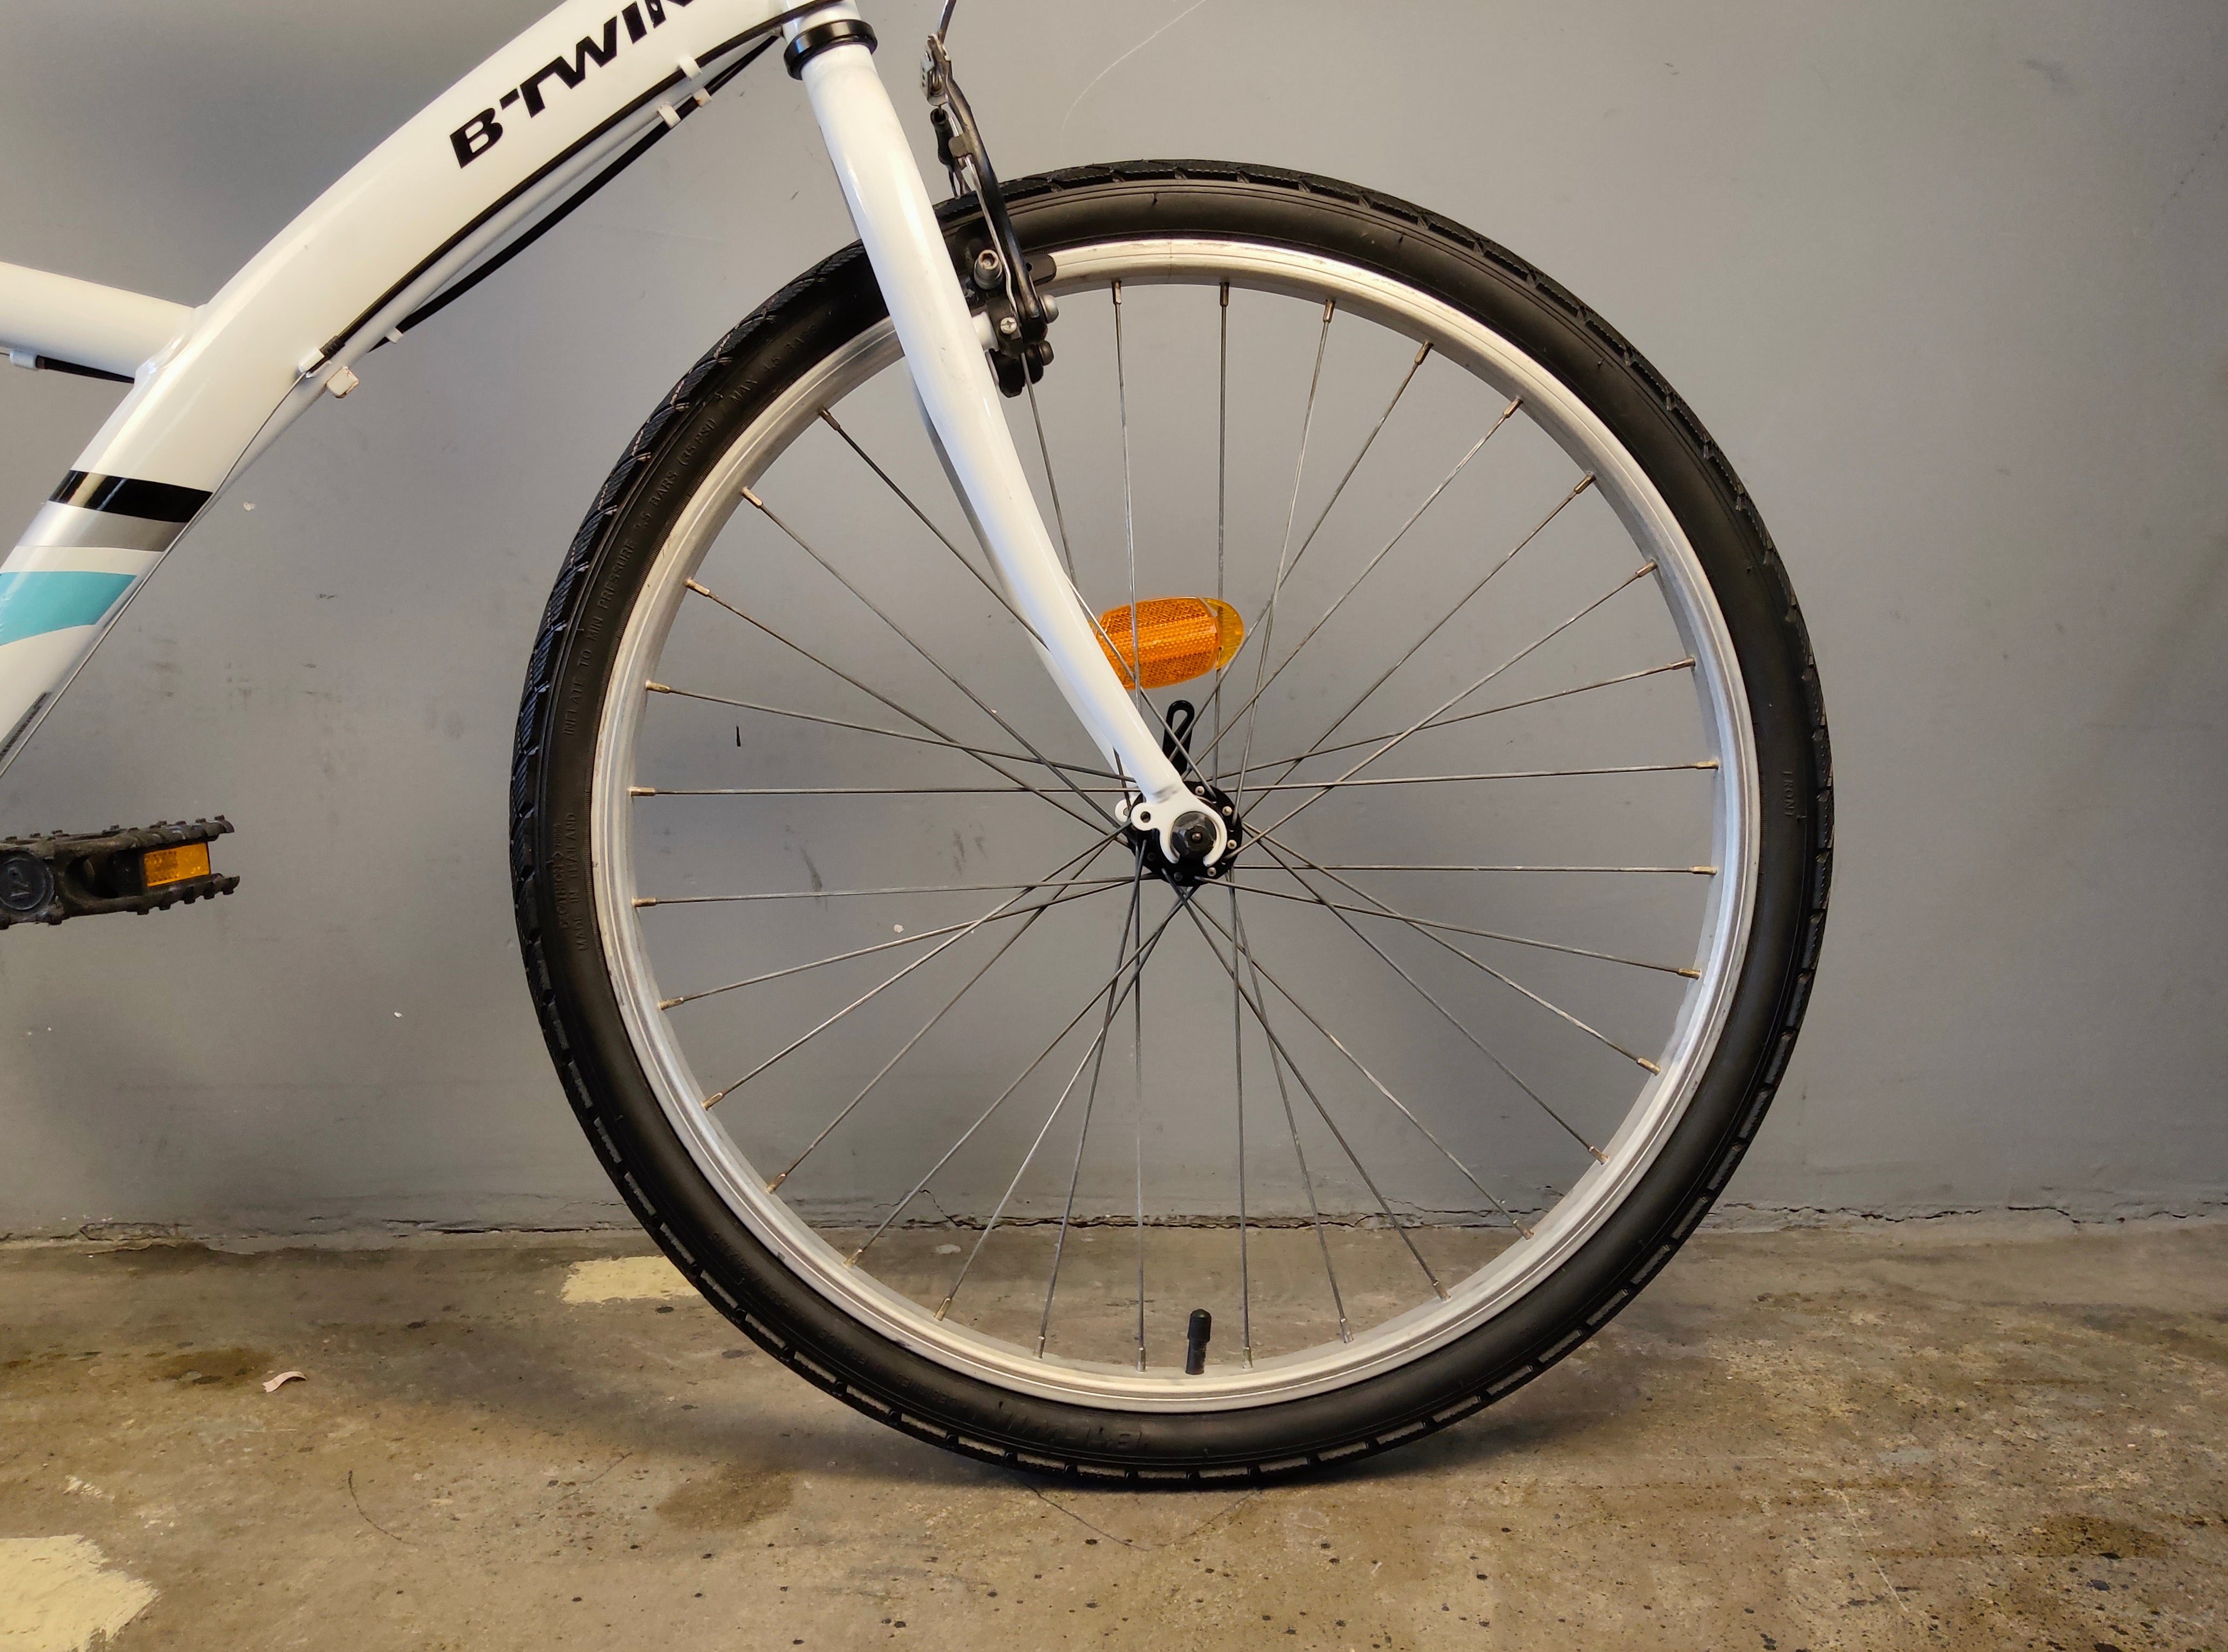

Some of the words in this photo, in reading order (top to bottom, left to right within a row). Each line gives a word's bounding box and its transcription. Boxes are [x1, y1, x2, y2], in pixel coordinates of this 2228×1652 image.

[578, 648, 592, 667] TO
[586, 616, 603, 641] MIN
[597, 539, 636, 609] PRESSURE
[649, 469, 678, 507] BARS
[1782, 770, 1795, 816] FRONT
[570, 890, 579, 902] IN
